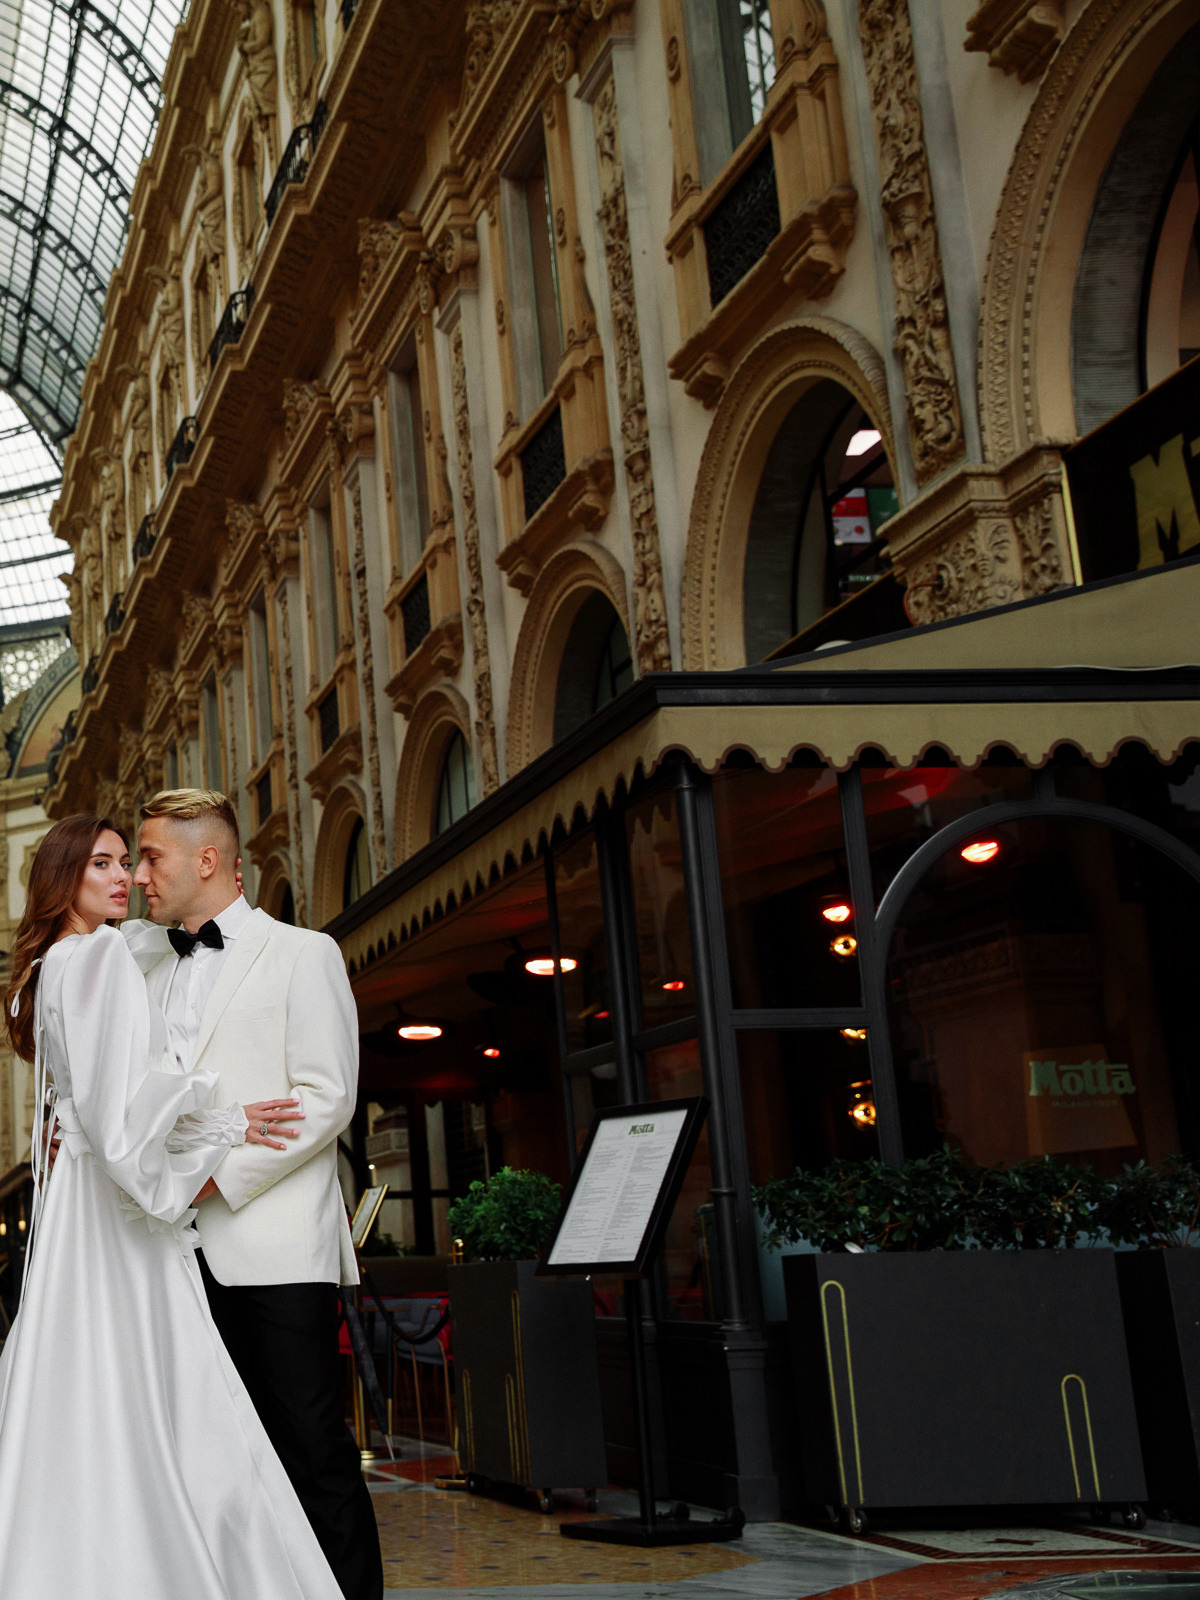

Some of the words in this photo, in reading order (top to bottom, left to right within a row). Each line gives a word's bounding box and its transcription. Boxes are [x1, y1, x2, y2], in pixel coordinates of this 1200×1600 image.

[1130, 433, 1200, 570] M
[1029, 1059, 1137, 1096] Motta
[628, 1123, 655, 1136] Motta
